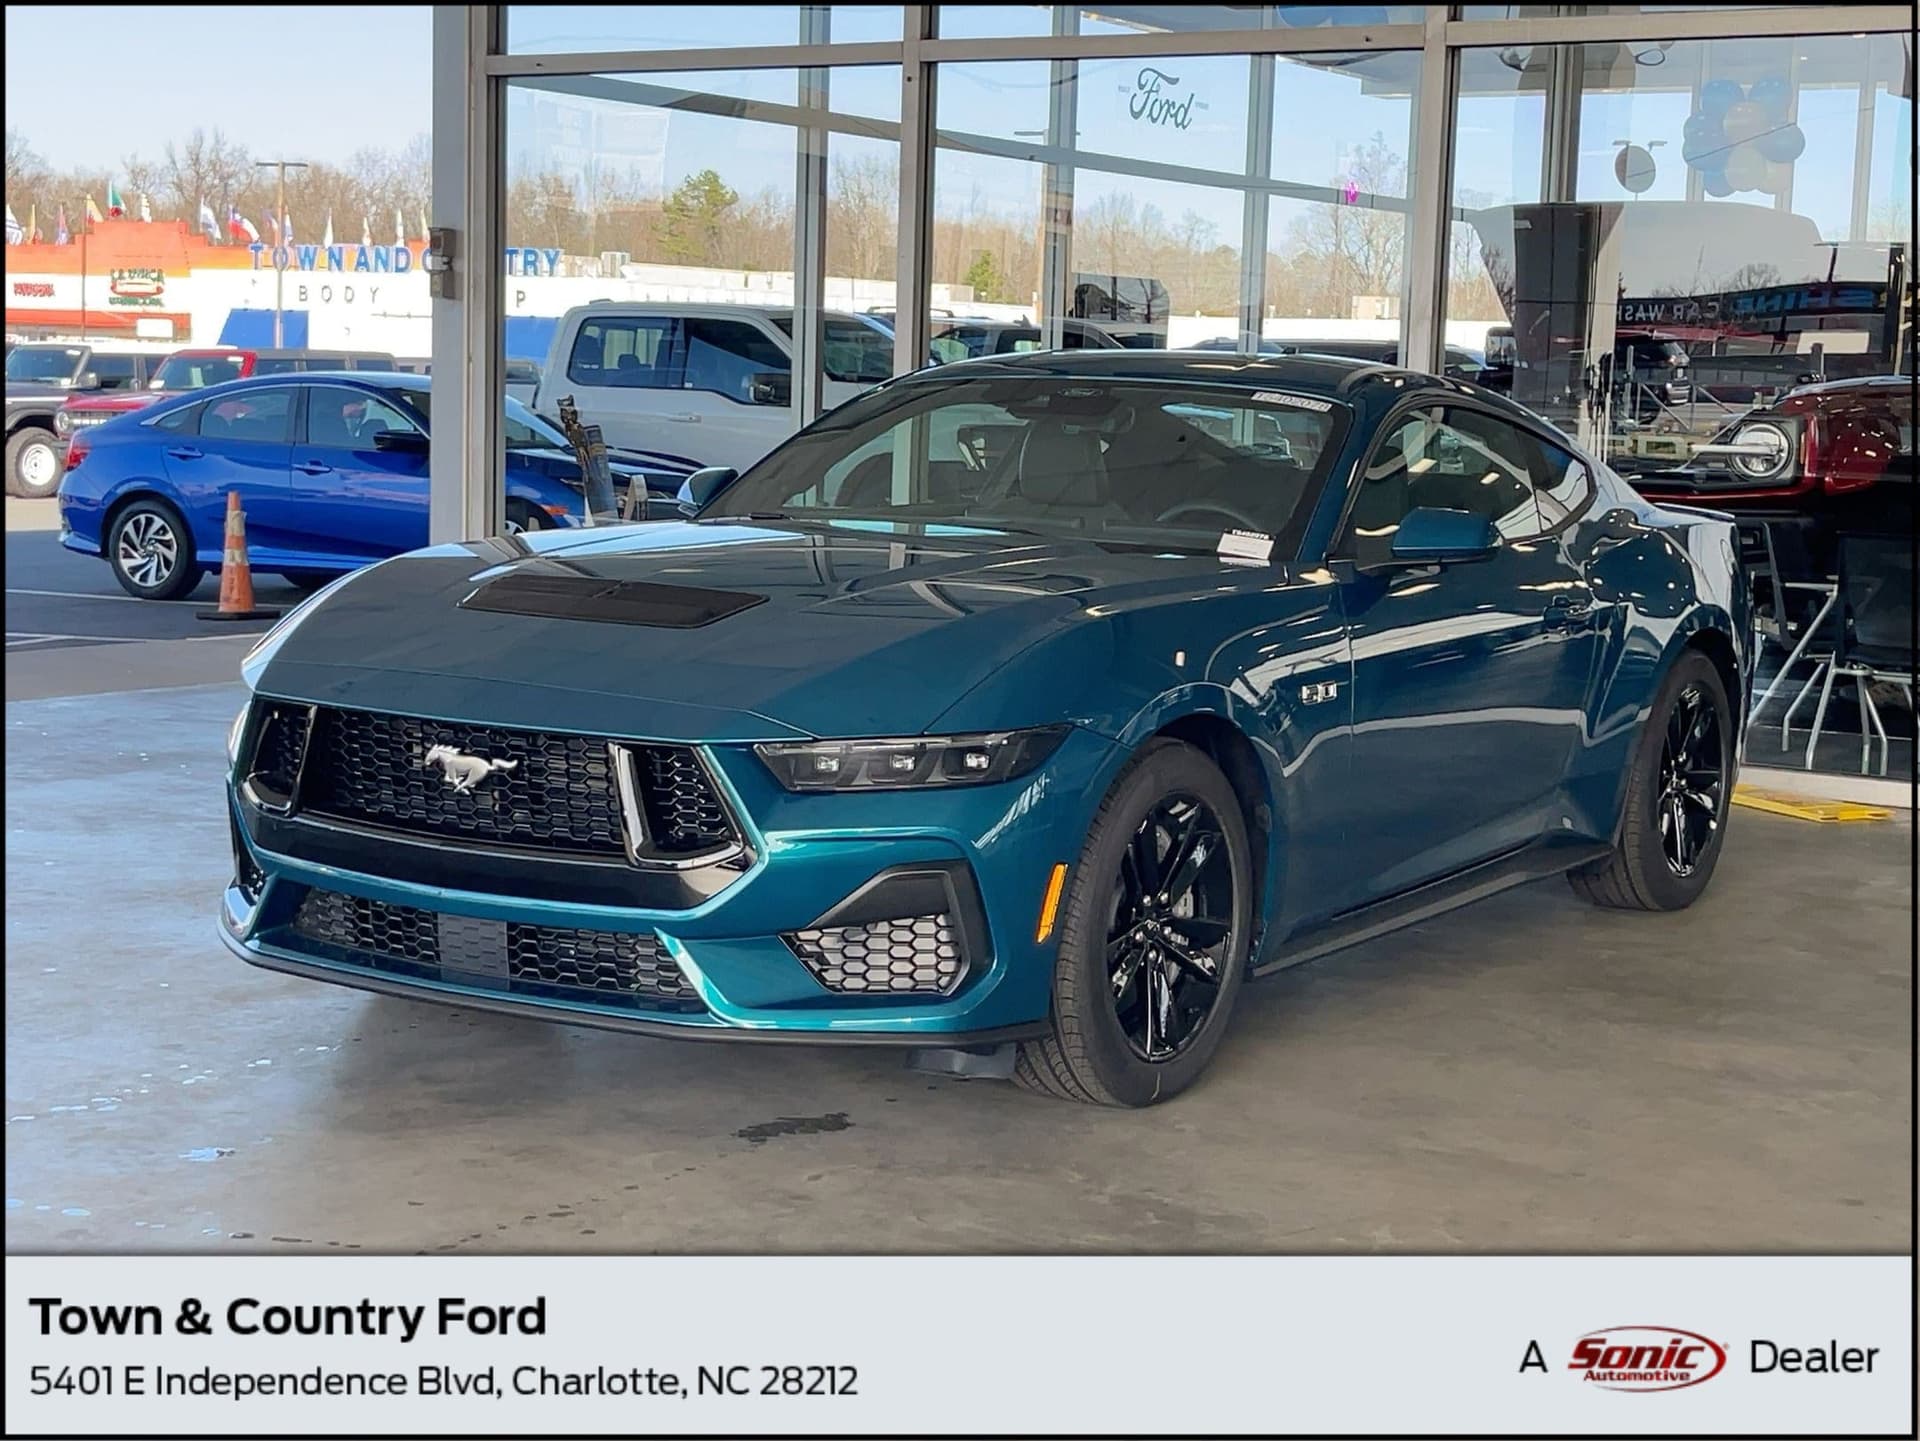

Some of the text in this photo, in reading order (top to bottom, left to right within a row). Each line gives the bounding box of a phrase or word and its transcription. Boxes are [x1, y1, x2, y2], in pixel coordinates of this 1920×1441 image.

[1129, 67, 1195, 130] Ford
[250, 243, 561, 277] TOWN AND CTRY
[299, 285, 380, 304] BODY
